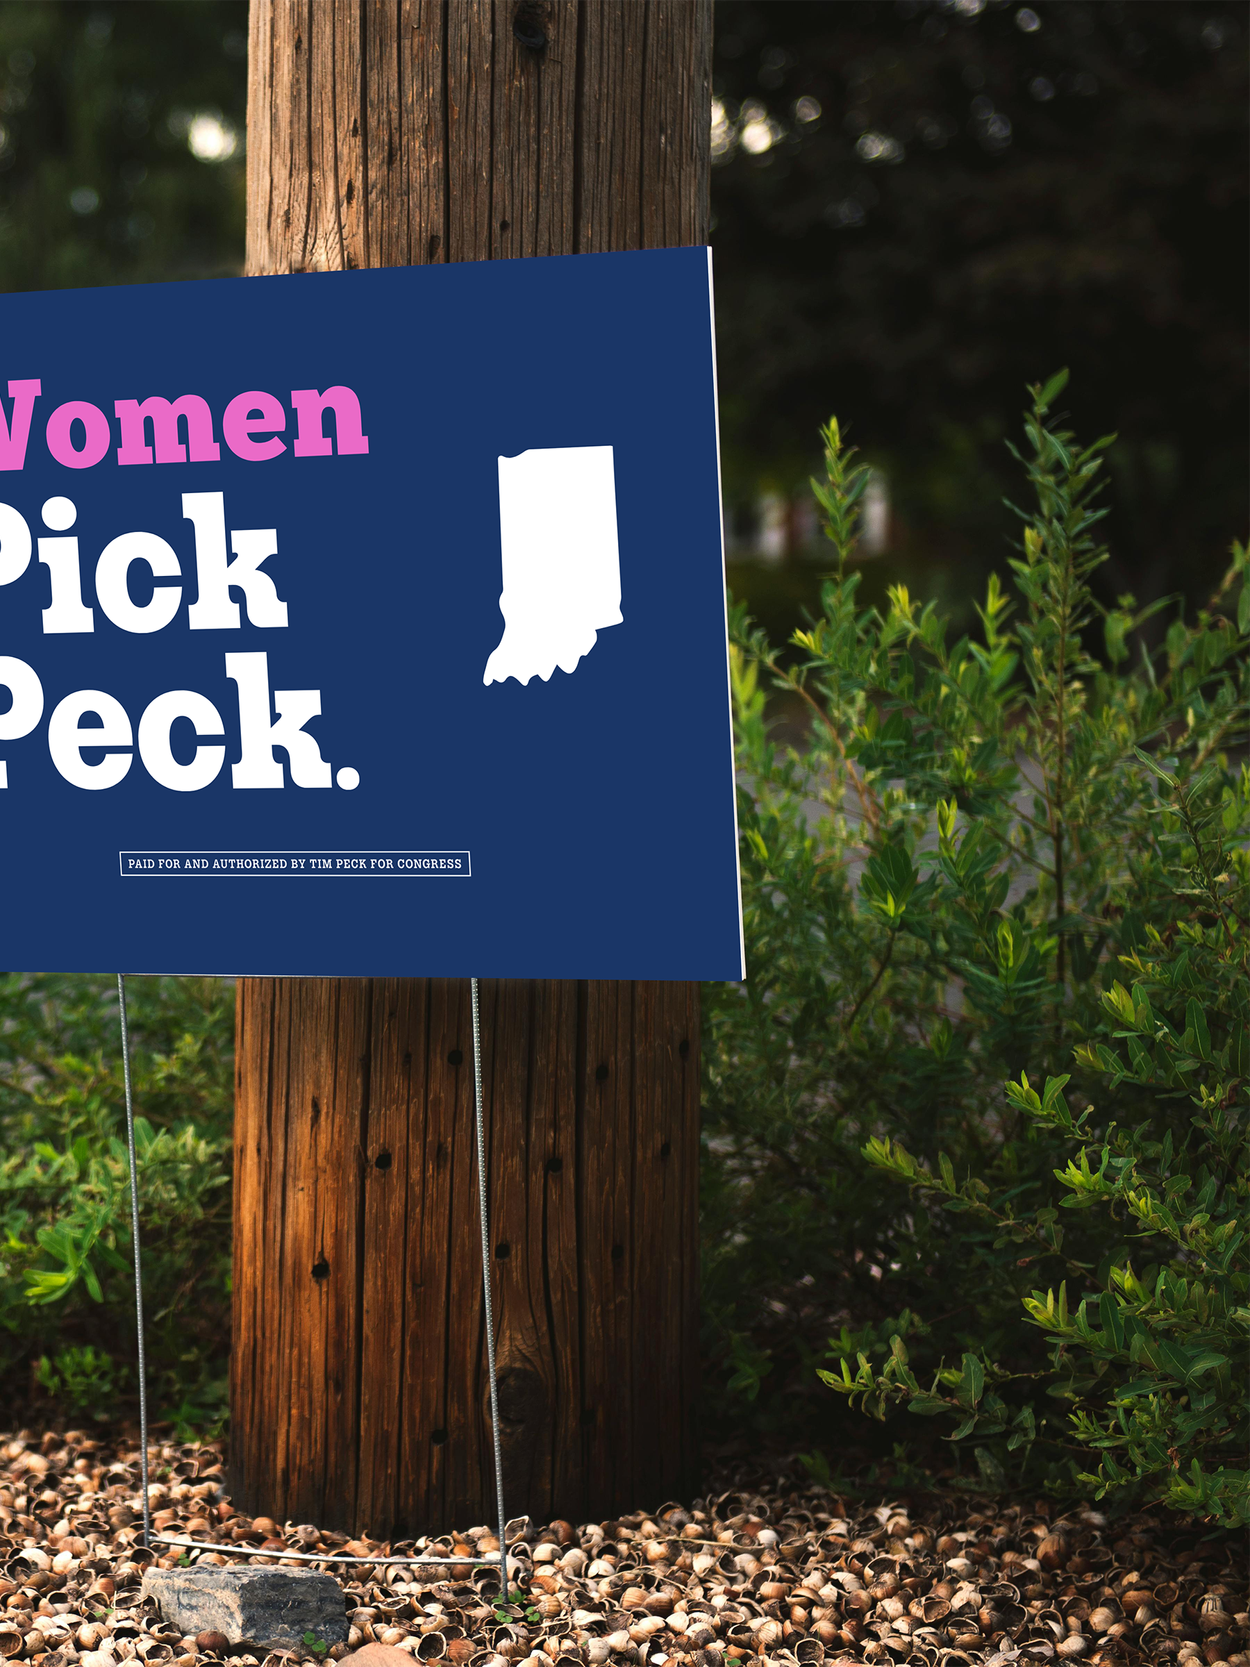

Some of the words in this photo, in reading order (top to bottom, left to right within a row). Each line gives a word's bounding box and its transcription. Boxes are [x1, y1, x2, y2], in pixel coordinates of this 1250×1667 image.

[128, 858, 154, 869] PAID
[158, 858, 180, 869] FOR
[184, 858, 208, 869] AND
[213, 858, 287, 869] AUTHORIZED
[291, 858, 305, 869] BY
[310, 858, 332, 869] TIM
[336, 858, 367, 869] PECK
[370, 858, 394, 869] FOR
[398, 858, 461, 869] CONGRESS
